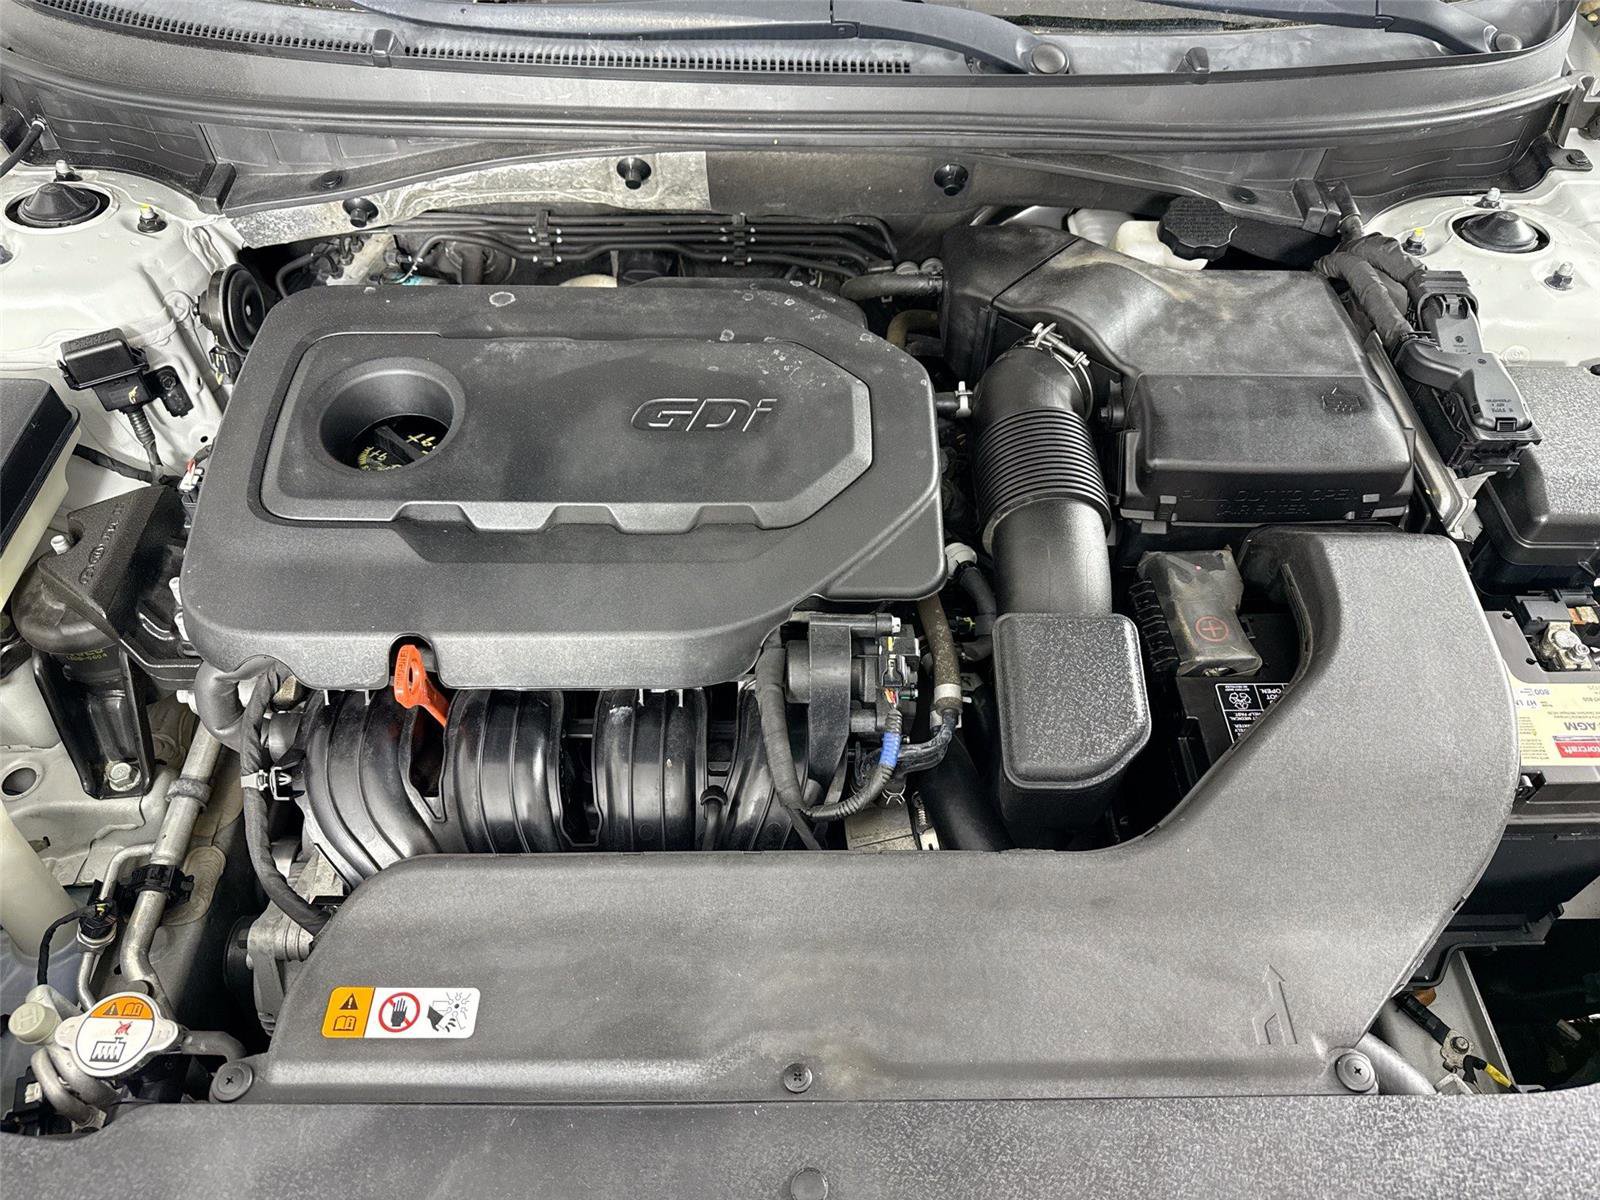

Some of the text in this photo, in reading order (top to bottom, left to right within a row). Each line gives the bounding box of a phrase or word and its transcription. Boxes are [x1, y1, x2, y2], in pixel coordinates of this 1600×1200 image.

[631, 398, 778, 432] GDi
[1279, 489, 1305, 502] TO
[1308, 488, 1359, 502] OPEN
[1563, 722, 1597, 731] AGM
